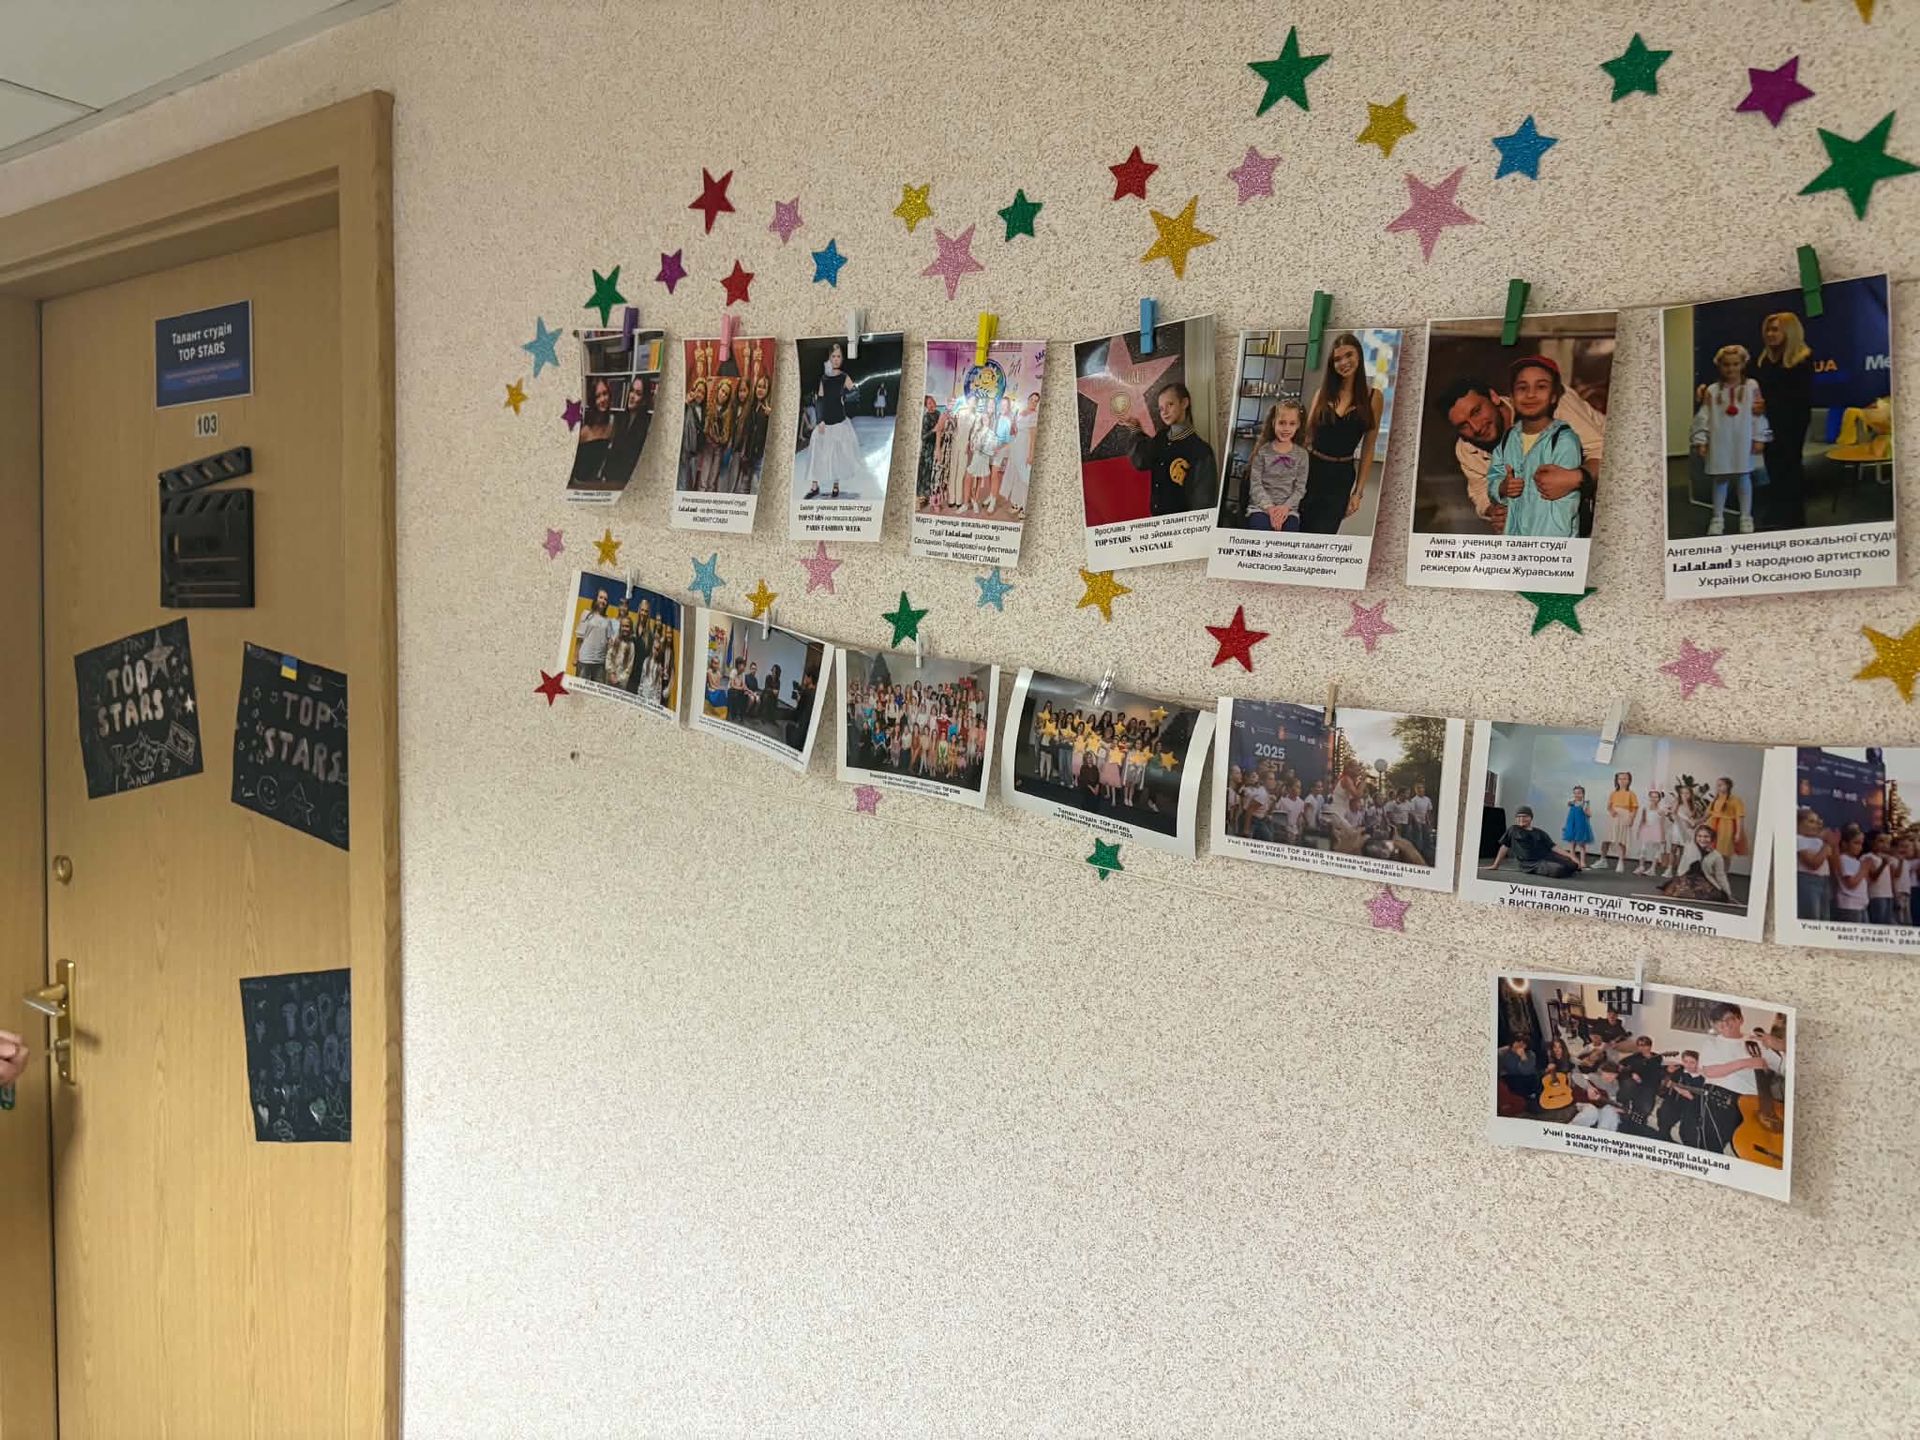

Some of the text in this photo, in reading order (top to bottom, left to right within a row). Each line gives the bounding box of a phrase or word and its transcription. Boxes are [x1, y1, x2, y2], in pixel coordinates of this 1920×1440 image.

[172, 322, 232, 345] Талант студія
[179, 341, 226, 361] TOP STARS
[197, 415, 217, 434] 103
[945, 529, 973, 539] LaLaLand
[1094, 525, 1126, 536] Ярослава
[1129, 520, 1160, 532] учениця
[1162, 516, 1187, 525] талант
[1094, 539, 1108, 547] TOP
[1108, 535, 1132, 545] STARS
[1150, 529, 1181, 540] зйомках
[1182, 525, 1211, 534] серіалу
[1139, 541, 1174, 553] SYGNALE
[1229, 536, 1261, 545] Полінка
[1329, 543, 1353, 553] студії
[1429, 537, 1568, 551] Аміна учениця талант студії
[1666, 545, 1722, 557] Ангеліна
[1731, 540, 1787, 555] учениця
[1789, 532, 1858, 548] вокальної
[952, 551, 978, 560] МОМЕНТ
[1217, 547, 1234, 555] TOP
[1234, 549, 1262, 557] STARS
[1273, 552, 1308, 560] зйомках
[1316, 553, 1363, 565] блогеркою
[1425, 549, 1443, 558] TOP
[1444, 550, 1476, 560] STARS
[1480, 552, 1509, 561] разом
[1517, 555, 1560, 564] актором
[1672, 549, 1890, 572] LaLaLand з народною артисткою
[1282, 564, 1337, 575] Захандревич
[1420, 564, 1575, 578] режисером Андрієм Журавським
[1698, 568, 1862, 587] України Оксаною Білозір
[106, 660, 149, 698] TOP
[98, 689, 164, 737] STARS
[282, 691, 331, 731] TOP
[265, 727, 342, 784] STARS
[1255, 743, 1286, 759] 2025
[1099, 819, 1111, 827] TOP
[1112, 823, 1130, 833] STARS
[1119, 830, 1133, 839] 2025
[1302, 850, 1324, 859] STARS
[1396, 865, 1431, 875] LaLaLand
[1499, 897, 1505, 905] з
[1508, 898, 1570, 913] виставою
[1574, 907, 1590, 916] на
[1593, 909, 1652, 925] звітному
[1509, 884, 1704, 920] Учні талант студії TOP STARS
[1800, 922, 1821, 931] Учні
[1825, 925, 1858, 933] талант
[281, 993, 332, 1037] TOP
[1543, 1127, 1731, 1170] Учні вокально-музичної студії LaLaLand
[1572, 1141, 1599, 1152] класу
[1601, 1145, 1630, 1157] гітари
[1645, 1155, 1709, 1175] квартирнику
